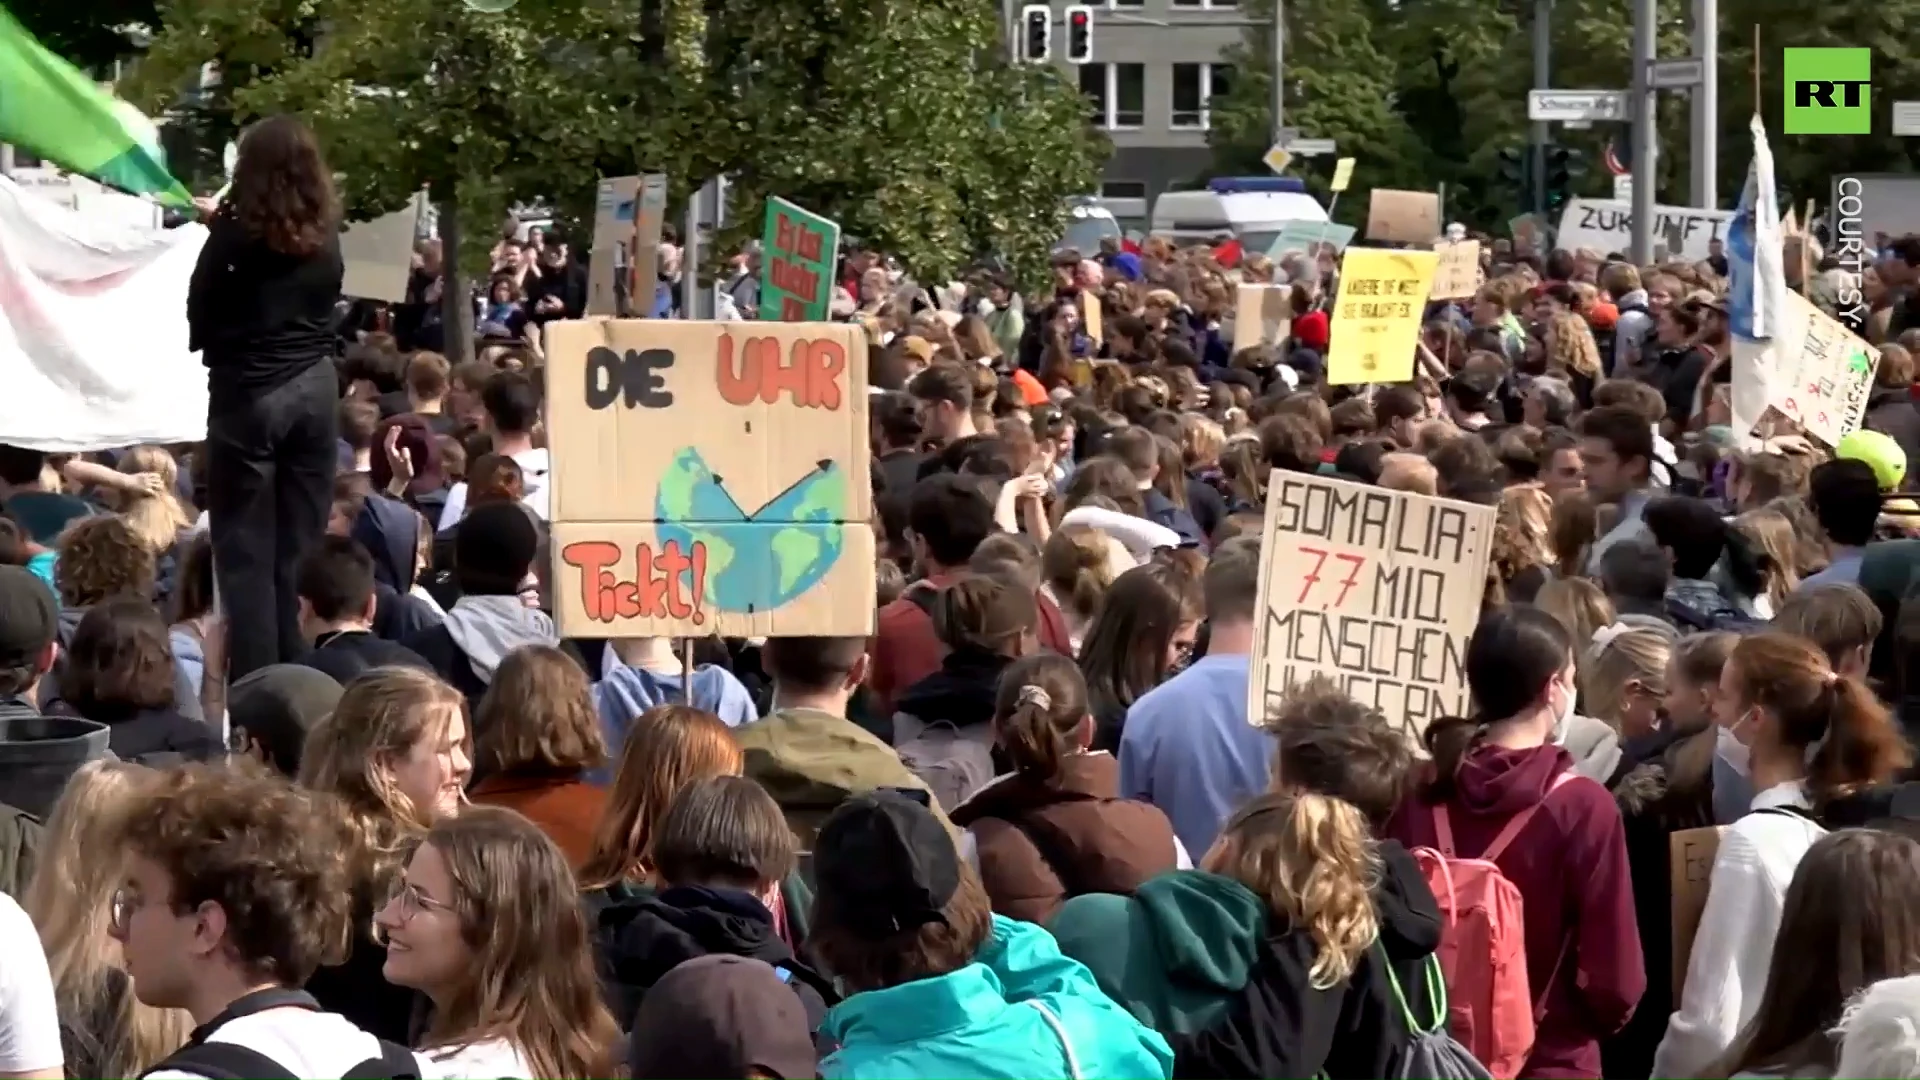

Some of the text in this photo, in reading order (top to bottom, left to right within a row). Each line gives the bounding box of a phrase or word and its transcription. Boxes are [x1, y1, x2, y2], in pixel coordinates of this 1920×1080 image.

[1579, 205, 1726, 240] ZUKNFT
[585, 333, 845, 411] DIE UHR
[1278, 480, 1476, 563] SOMALIA:
[562, 540, 706, 625] Tickt!
[1298, 547, 1448, 624] 7,7 MIO.
[1264, 605, 1471, 688] MENSCHEN
